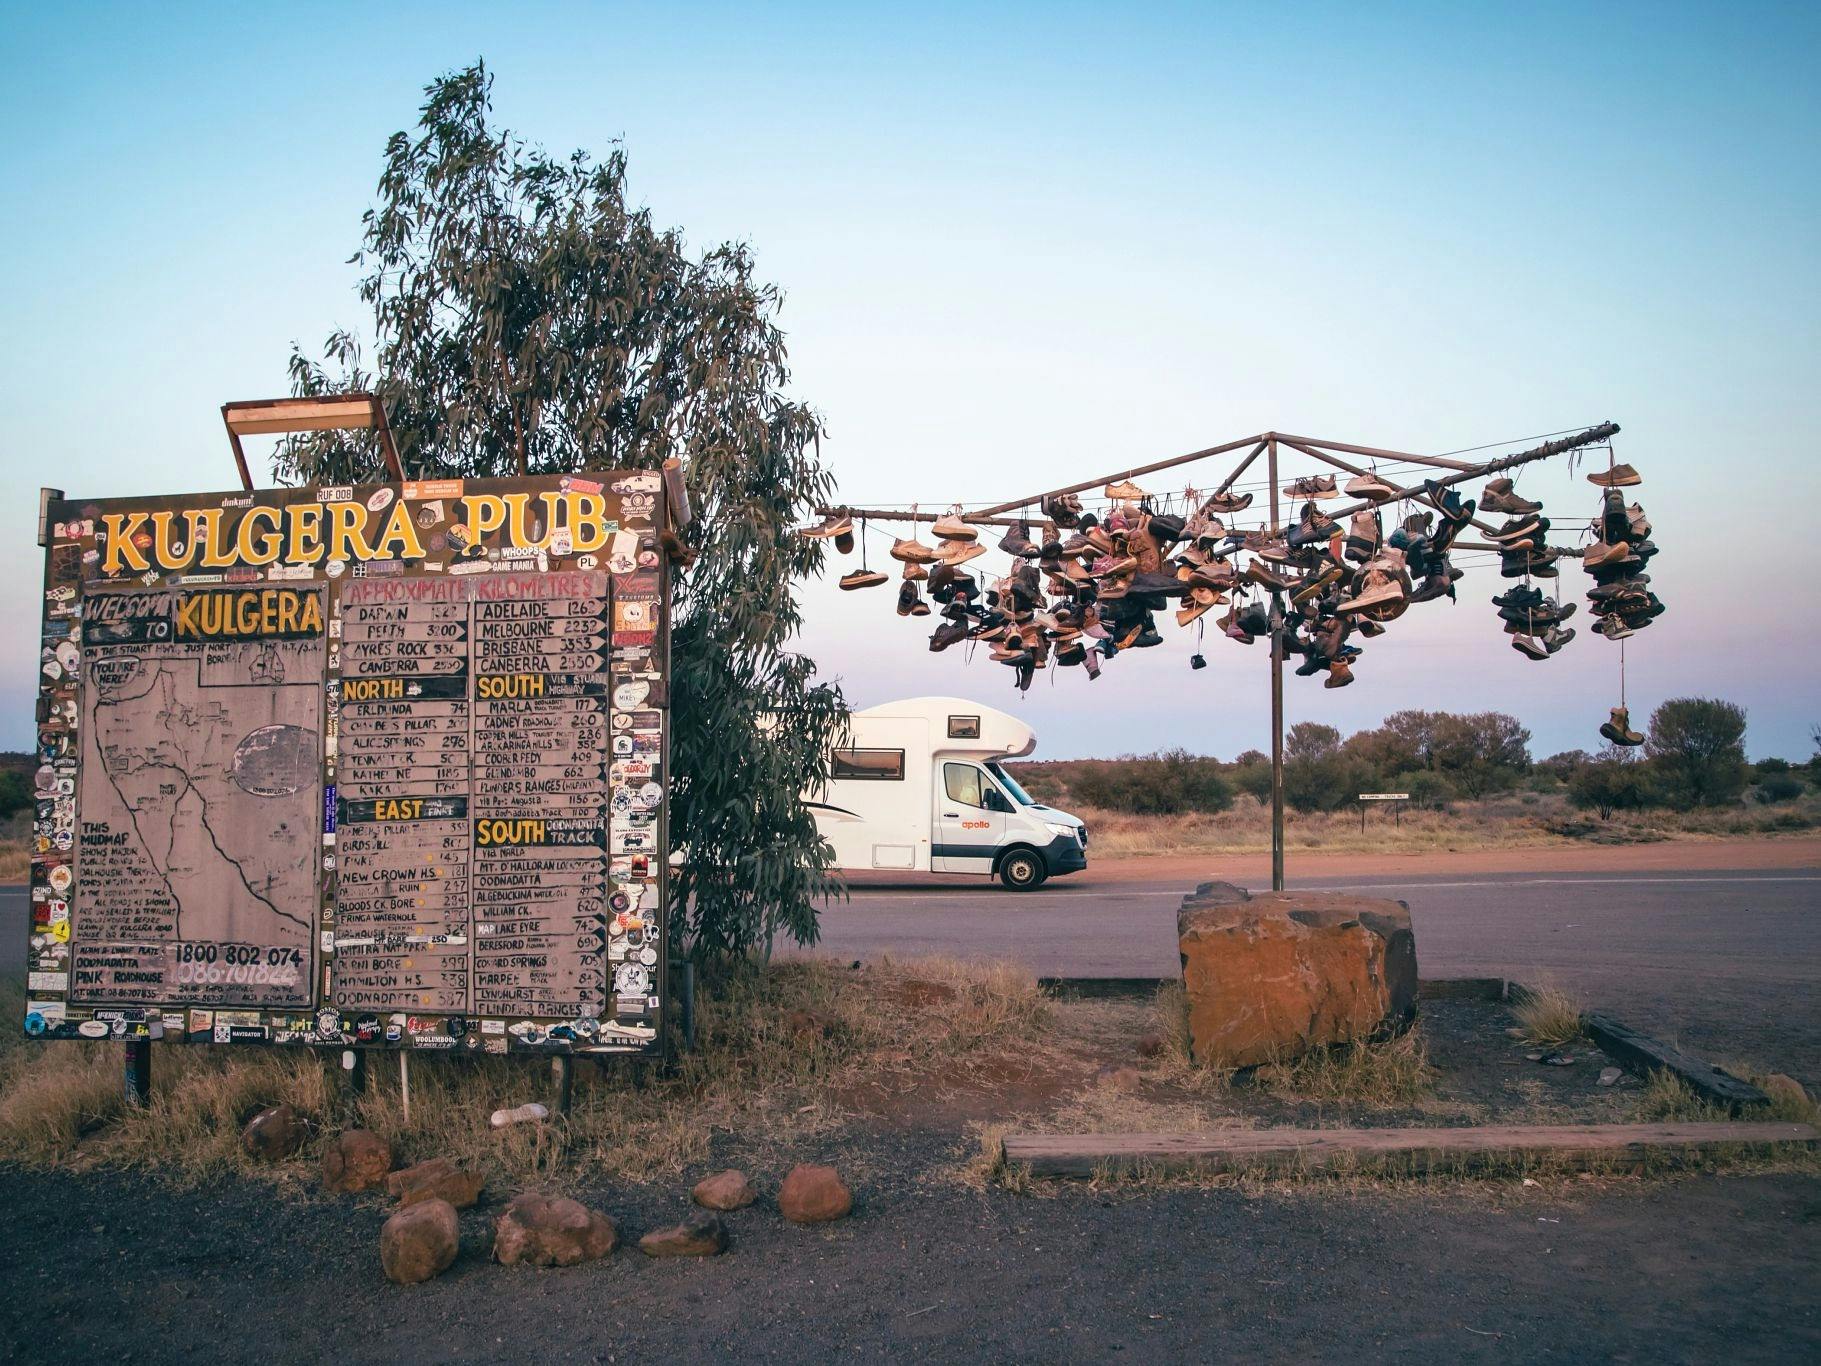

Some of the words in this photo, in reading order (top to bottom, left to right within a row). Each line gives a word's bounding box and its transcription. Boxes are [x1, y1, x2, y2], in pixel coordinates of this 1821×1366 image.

[318, 490, 334, 501] RUF
[102, 499, 427, 573] KULGERA
[461, 491, 610, 557] PUB
[502, 547, 539, 557] WHOOPS
[492, 561, 512, 571] GAME
[512, 561, 534, 570] MANIA
[580, 558, 594, 567] PL
[351, 579, 466, 602] APPROXIMATE
[480, 575, 593, 599] KILOMETRES
[176, 590, 323, 640] KULGERA
[359, 606, 408, 620] DARWN
[482, 603, 549, 619] ADELAIDE
[146, 621, 168, 638] TO
[482, 620, 555, 638] MELBOURNE
[84, 649, 97, 657] ON
[101, 646, 117, 656] THE
[120, 644, 153, 654] STUART
[184, 643, 206, 652] JUST
[396, 642, 428, 655] ROCK
[482, 640, 543, 656] BRISBANE
[96, 662, 116, 673] YOU
[117, 662, 135, 672] ARE
[480, 656, 551, 672] CANBERRA
[99, 673, 130, 684] HERE!
[343, 680, 403, 701] NORTH
[478, 674, 544, 698] SOUTH
[450, 703, 467, 714] 74
[489, 701, 533, 714] MARLA
[485, 716, 521, 729] CADNEY
[485, 753, 518, 765] COOBER
[353, 768, 411, 779] KATHENE
[564, 767, 583, 777] 662
[525, 780, 561, 793] RANGES
[375, 800, 424, 820] EAST
[542, 808, 563, 816] Track
[82, 822, 110, 833] THIS
[546, 819, 605, 831] OODNADATTA
[962, 820, 990, 830] apollo
[478, 819, 545, 845] SOUTH
[551, 831, 595, 843] TRACK
[80, 832, 129, 846] MUDMAP
[80, 847, 107, 857] SHOWS
[111, 847, 138, 856] MAJOR
[500, 847, 525, 857] MARLA
[480, 862, 497, 872] MT.
[500, 860, 555, 871] O'HALLORAN
[342, 872, 368, 882] NEW
[372, 868, 417, 880] CROWN
[480, 874, 541, 886] OODNADATTA
[399, 883, 420, 892] RUIN
[476, 889, 532, 902] ALGEBUCKINA
[338, 901, 371, 912] BLOODS
[390, 898, 415, 909] BORE
[483, 906, 515, 917] WILLIAM
[518, 906, 532, 916] CK.
[577, 901, 599, 912] 620
[373, 912, 417, 921] WATERHOLE
[120, 923, 152, 931] KULGERA
[478, 926, 494, 934] MAP
[495, 923, 517, 934] LAKE
[520, 921, 540, 932] EYRE
[431, 935, 448, 943] 250
[478, 939, 524, 951] BERESFORD
[176, 943, 218, 963] 1800
[225, 945, 261, 966] 802
[76, 957, 139, 969] OODNADATTA
[510, 955, 547, 967] SPRINGS
[75, 971, 103, 984] PINK
[114, 972, 164, 984] ROADHOUSE
[481, 989, 535, 1000] LYNDHURST
[316, 1006, 341, 1017] BOSTON
[538, 1003, 583, 1015] RANGES
